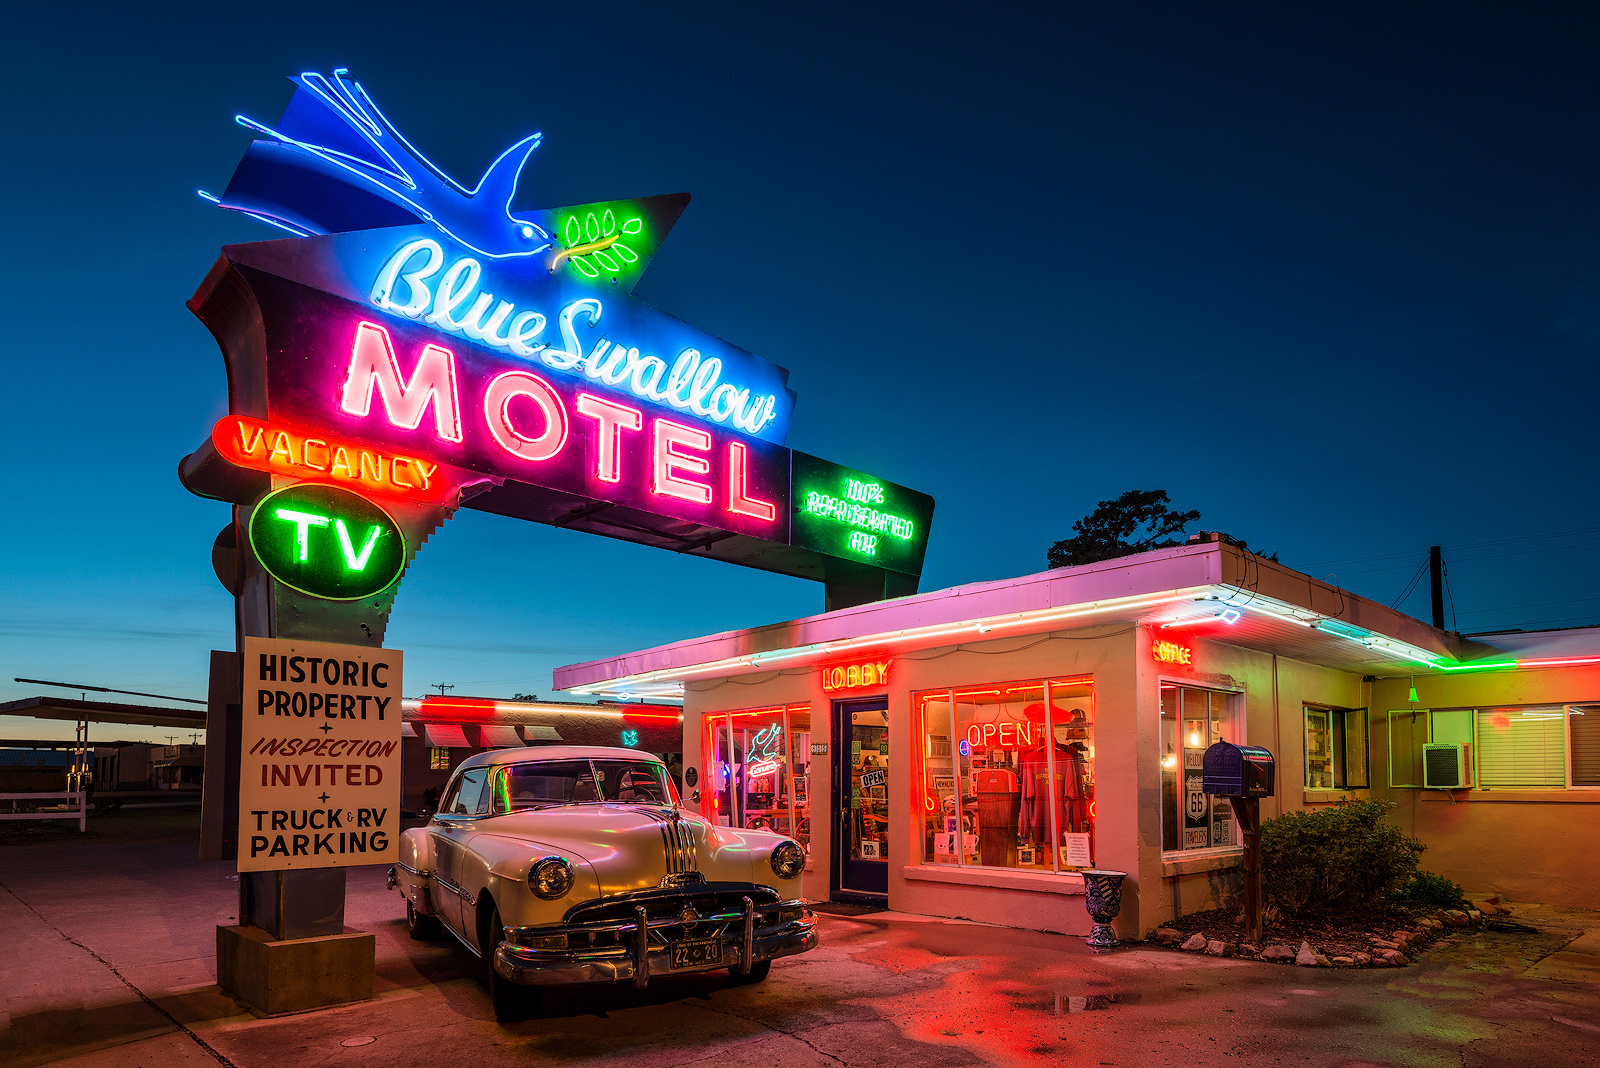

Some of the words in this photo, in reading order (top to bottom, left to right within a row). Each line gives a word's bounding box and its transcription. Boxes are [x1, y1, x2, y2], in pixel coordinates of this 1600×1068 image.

[370, 238, 549, 356] Blue
[540, 299, 776, 433] Swallow
[341, 320, 776, 522] MOTEL
[237, 421, 438, 490] VACANCY
[843, 478, 885, 504] 100%
[805, 491, 914, 540] REFRIGERATED
[274, 508, 382, 571] TV
[847, 531, 877, 556] AIR
[1155, 641, 1192, 665] OFFICE
[259, 653, 389, 688] HISTORIC
[822, 661, 891, 692] LOBBY
[257, 689, 392, 720] PROPERTY
[967, 721, 1031, 747] OPEN
[249, 737, 398, 758] INSPECTION
[1185, 752, 1204, 767] WELCOM
[261, 764, 383, 787] INVITED
[863, 770, 884, 787] OPEN
[1191, 792, 1203, 813] 66
[250, 808, 343, 831] TRUCK
[346, 812, 355, 822] &
[357, 808, 388, 828] RV
[250, 831, 389, 858] PARKING
[1185, 829, 1207, 845] TRAVELERS
[675, 948, 689, 964] 22
[704, 944, 718, 960] 20
